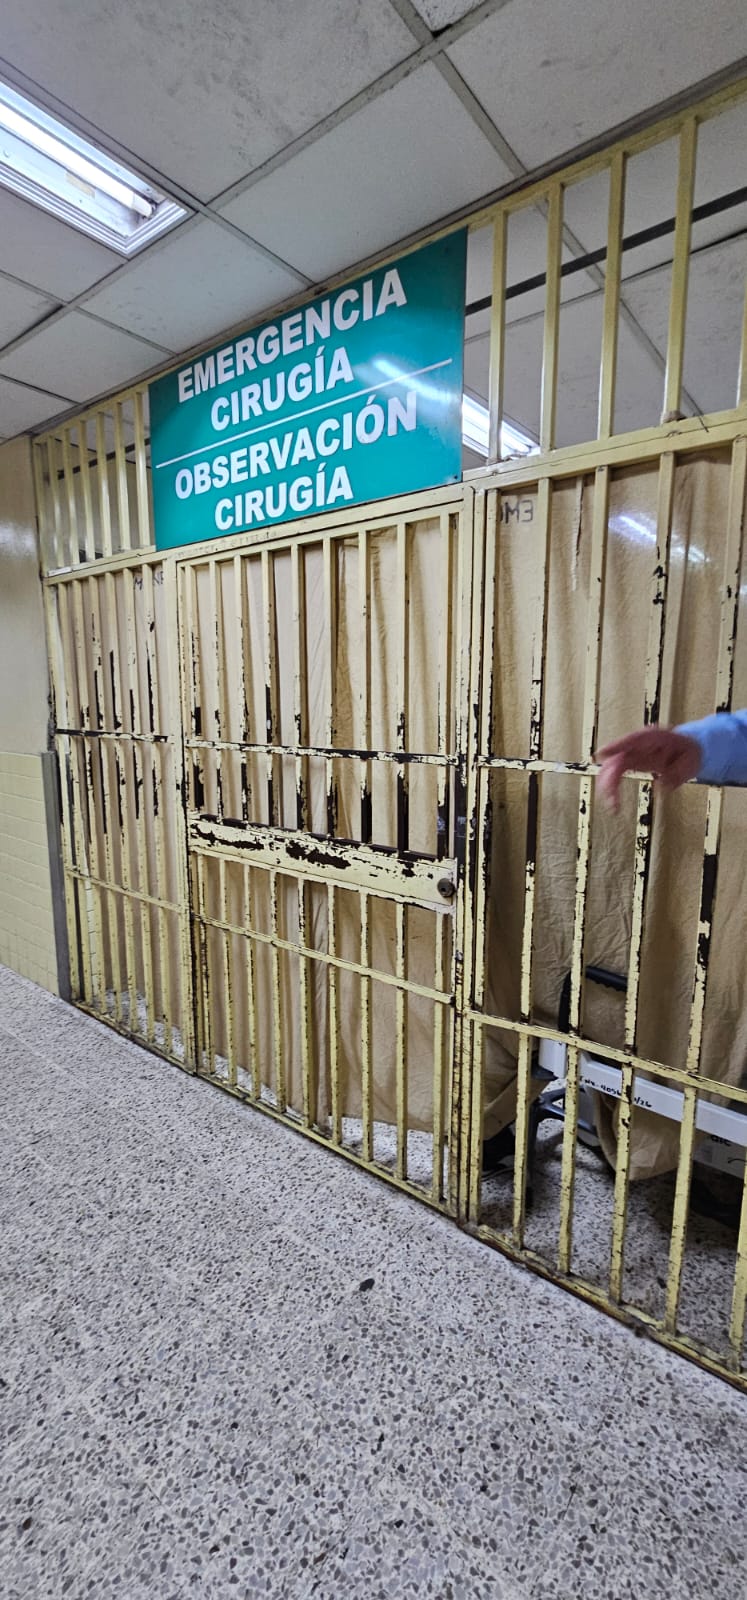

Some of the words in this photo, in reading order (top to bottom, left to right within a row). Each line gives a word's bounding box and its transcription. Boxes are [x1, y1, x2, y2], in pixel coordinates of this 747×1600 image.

[178, 268, 408, 403] EMERGENCIA
[210, 346, 354, 432] CIRUGÍA
[175, 391, 417, 500] OBSERVACIÓN
[214, 464, 354, 531] CIRUGÍA
